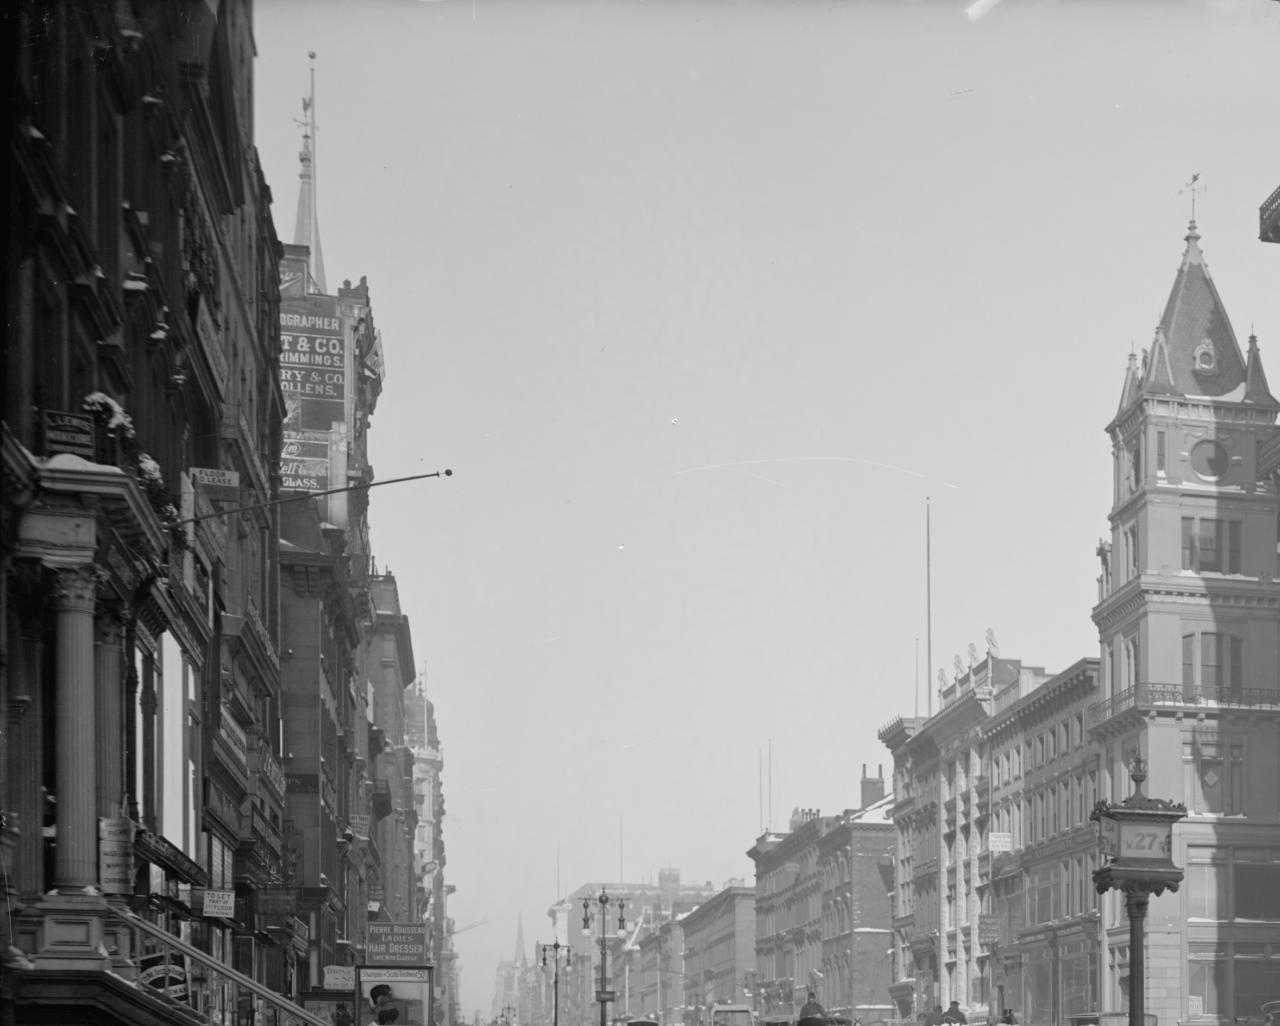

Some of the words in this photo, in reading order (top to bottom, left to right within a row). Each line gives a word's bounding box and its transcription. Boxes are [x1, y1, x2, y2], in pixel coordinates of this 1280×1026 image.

[297, 336, 311, 352] &
[315, 338, 344, 354] CO.
[309, 371, 322, 382] &
[325, 373, 344, 385] CO.
[207, 477, 233, 485] LEASE
[1104, 821, 1115, 832] 234
[1134, 831, 1159, 850] 27
[369, 925, 391, 934] PIERRE
[393, 925, 425, 934] ROUSSEAU
[381, 934, 413, 942] LADIES
[368, 943, 386, 953] HAIR
[389, 944, 423, 954] DRESSER
[362, 971, 383, 979] Shampoo
[386, 971, 399, 979] Scalp
